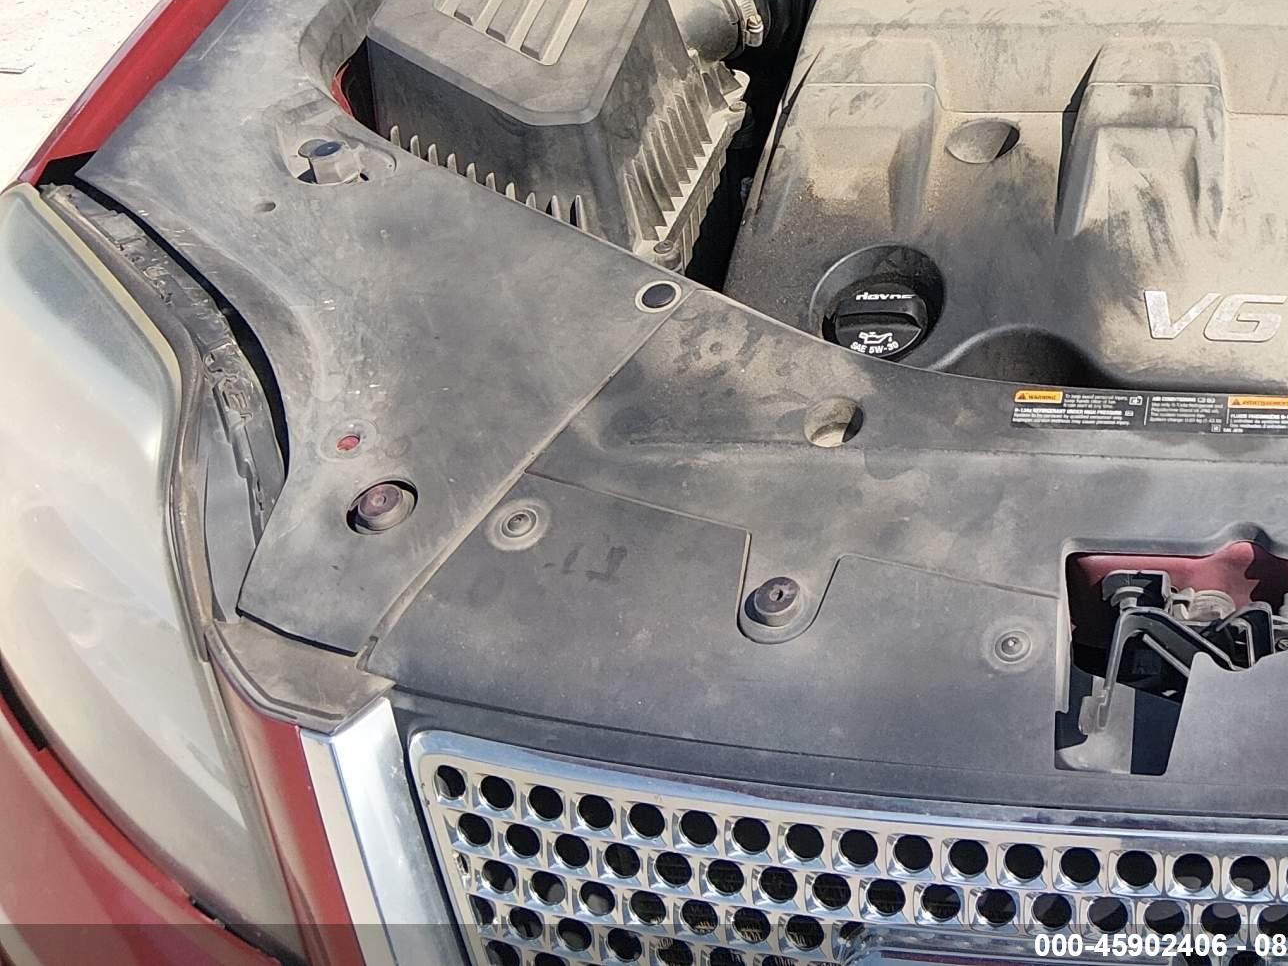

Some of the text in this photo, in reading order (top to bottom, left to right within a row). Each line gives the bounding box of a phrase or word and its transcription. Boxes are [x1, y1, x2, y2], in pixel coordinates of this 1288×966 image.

[1143, 290, 1288, 343] V6
[850, 341, 899, 353] SAE 5W-30
